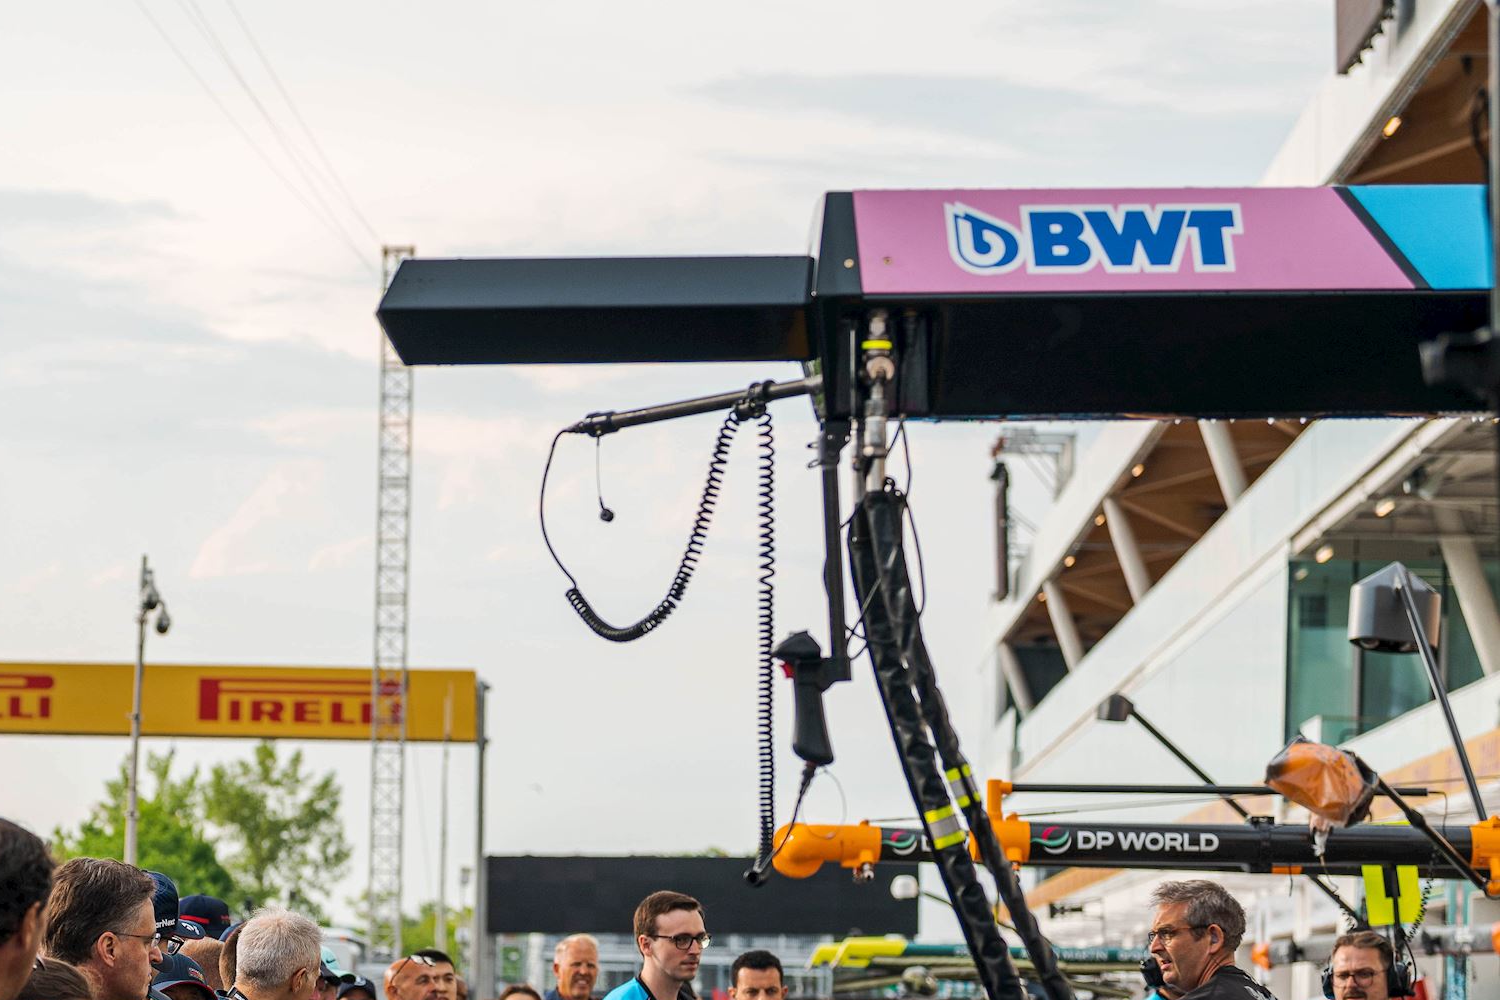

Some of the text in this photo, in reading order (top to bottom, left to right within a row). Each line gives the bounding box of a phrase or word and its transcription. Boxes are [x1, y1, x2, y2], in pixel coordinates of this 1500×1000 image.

[1022, 205, 1243, 273] BWT
[1077, 831, 1219, 851] DP WORLD
